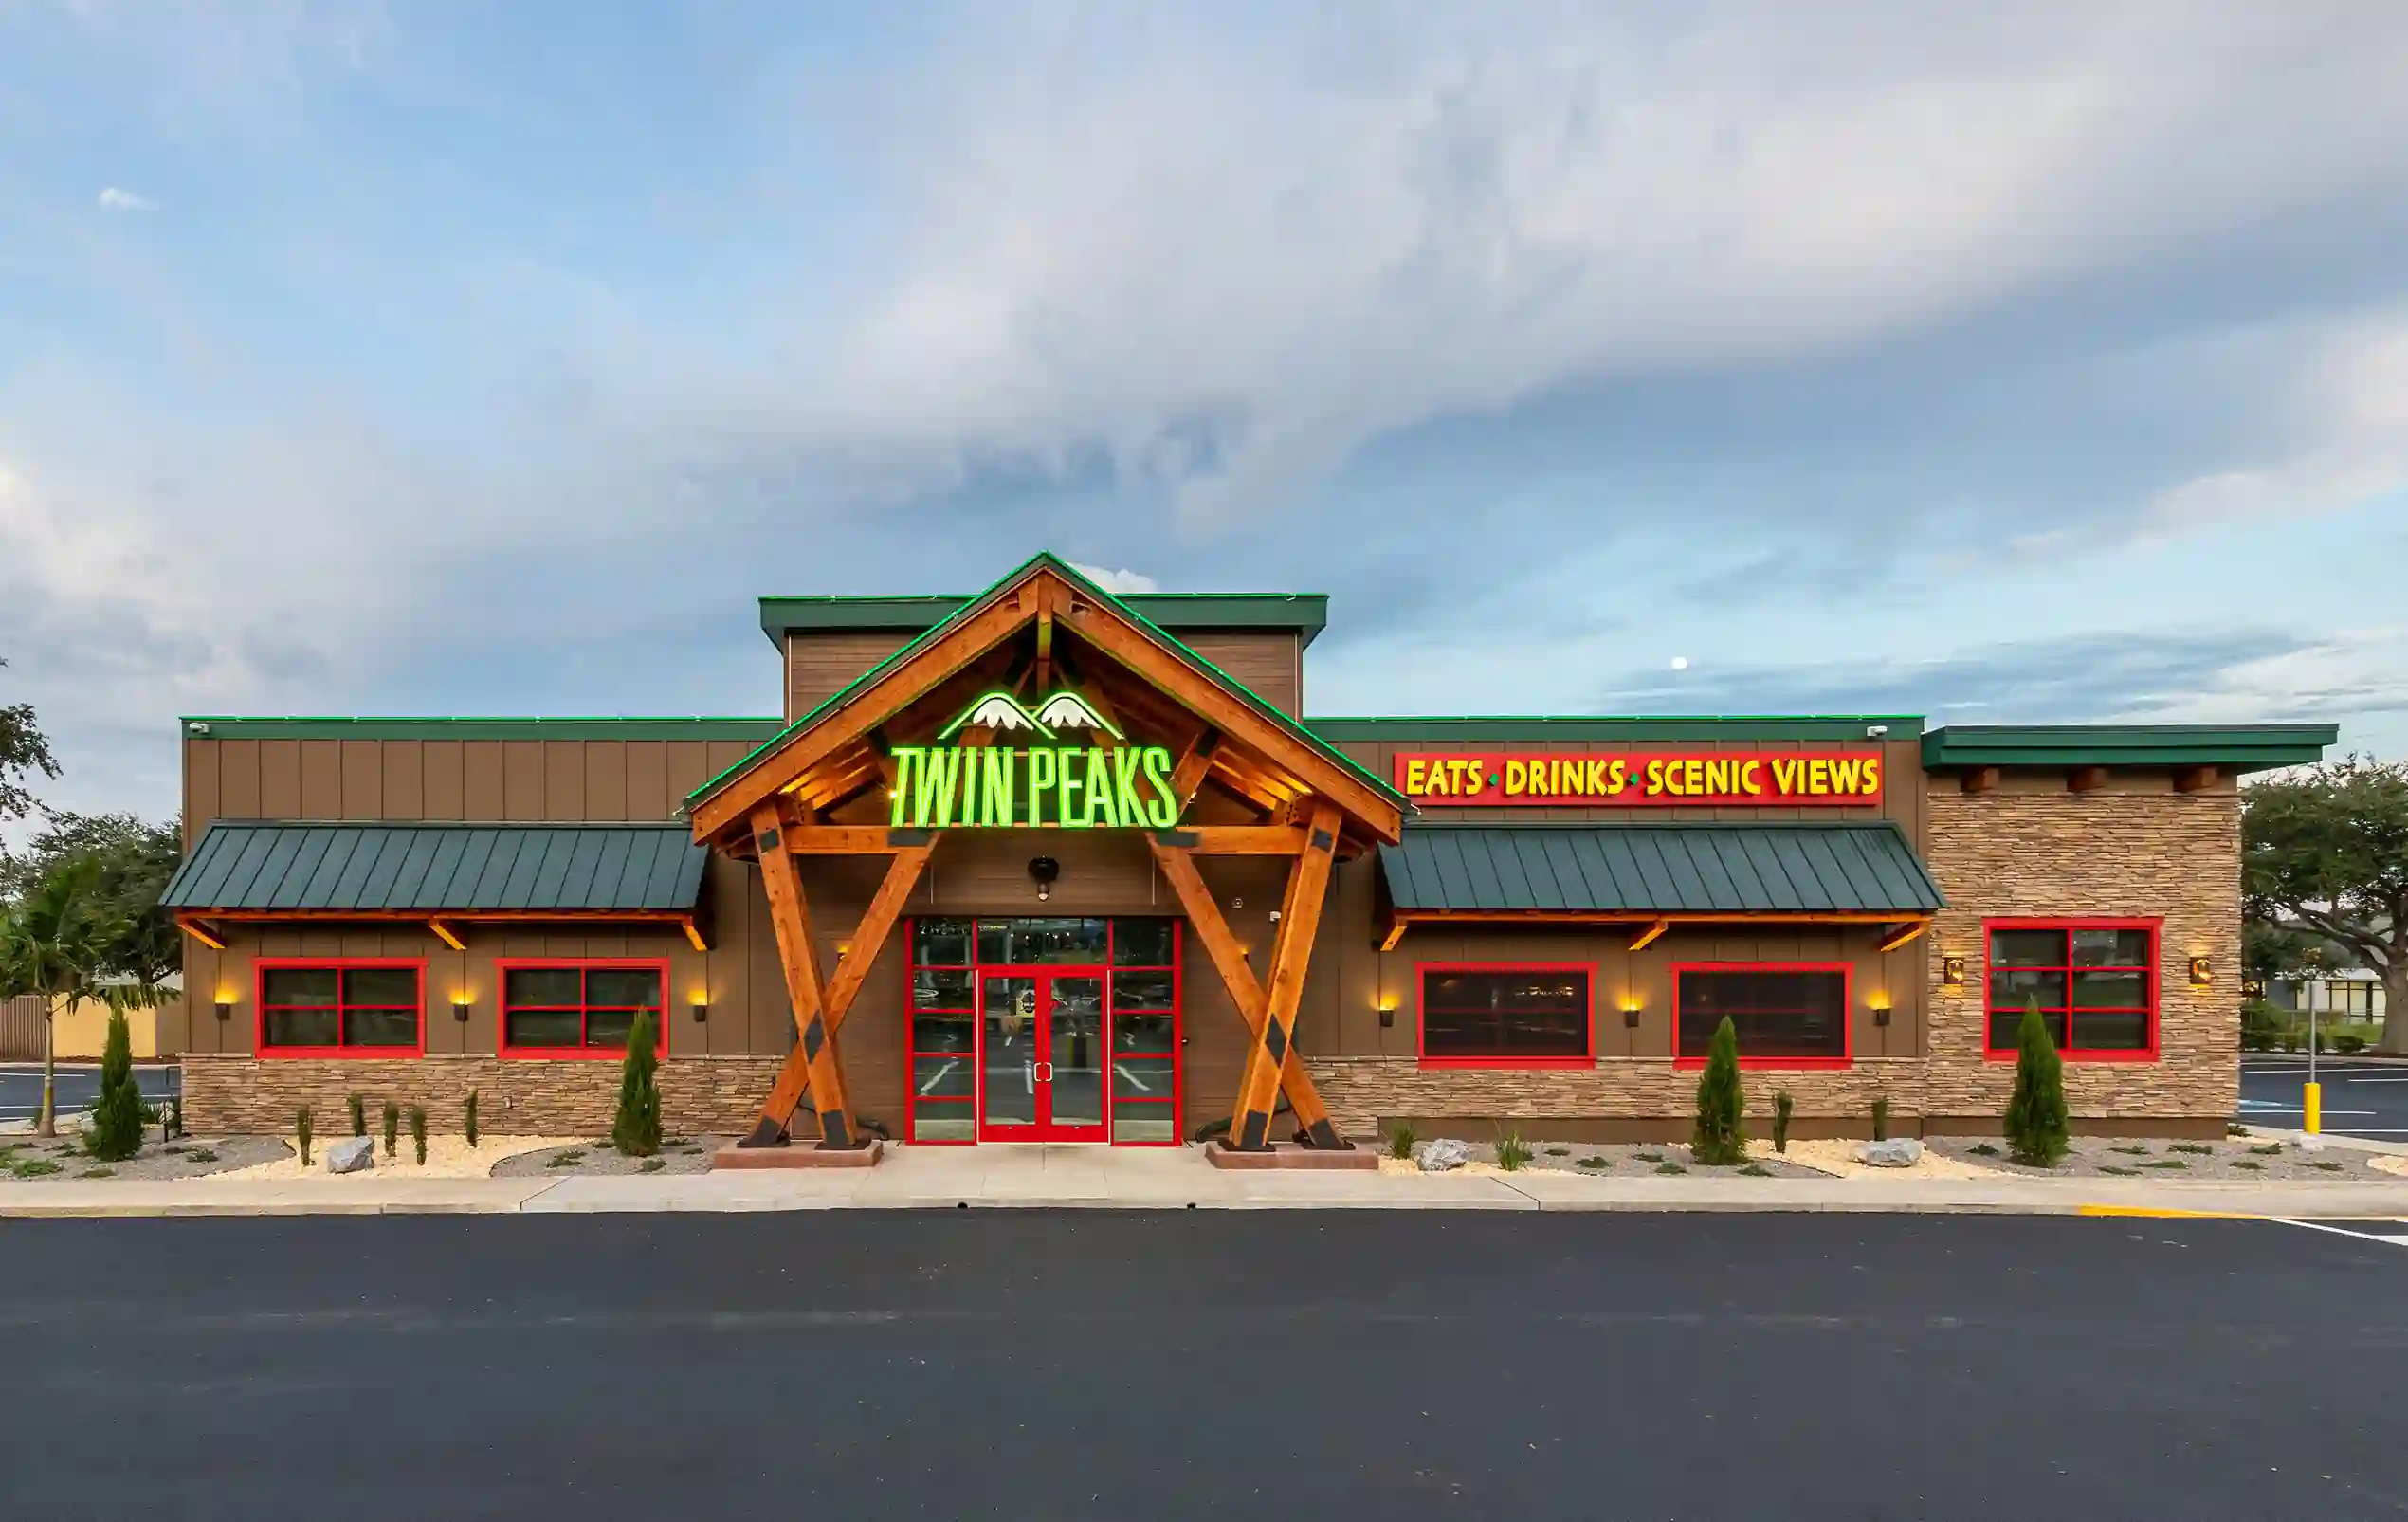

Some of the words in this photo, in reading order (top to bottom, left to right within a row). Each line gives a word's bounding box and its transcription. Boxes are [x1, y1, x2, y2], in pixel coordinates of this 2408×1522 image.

[891, 746, 1014, 828] TWIN
[1028, 746, 1178, 828] PEAKS
[1407, 760, 1483, 795] EATS
[1505, 760, 1625, 795] DRINKS
[1646, 760, 1761, 795] SCENIC
[1772, 758, 1879, 795] VIEWS
